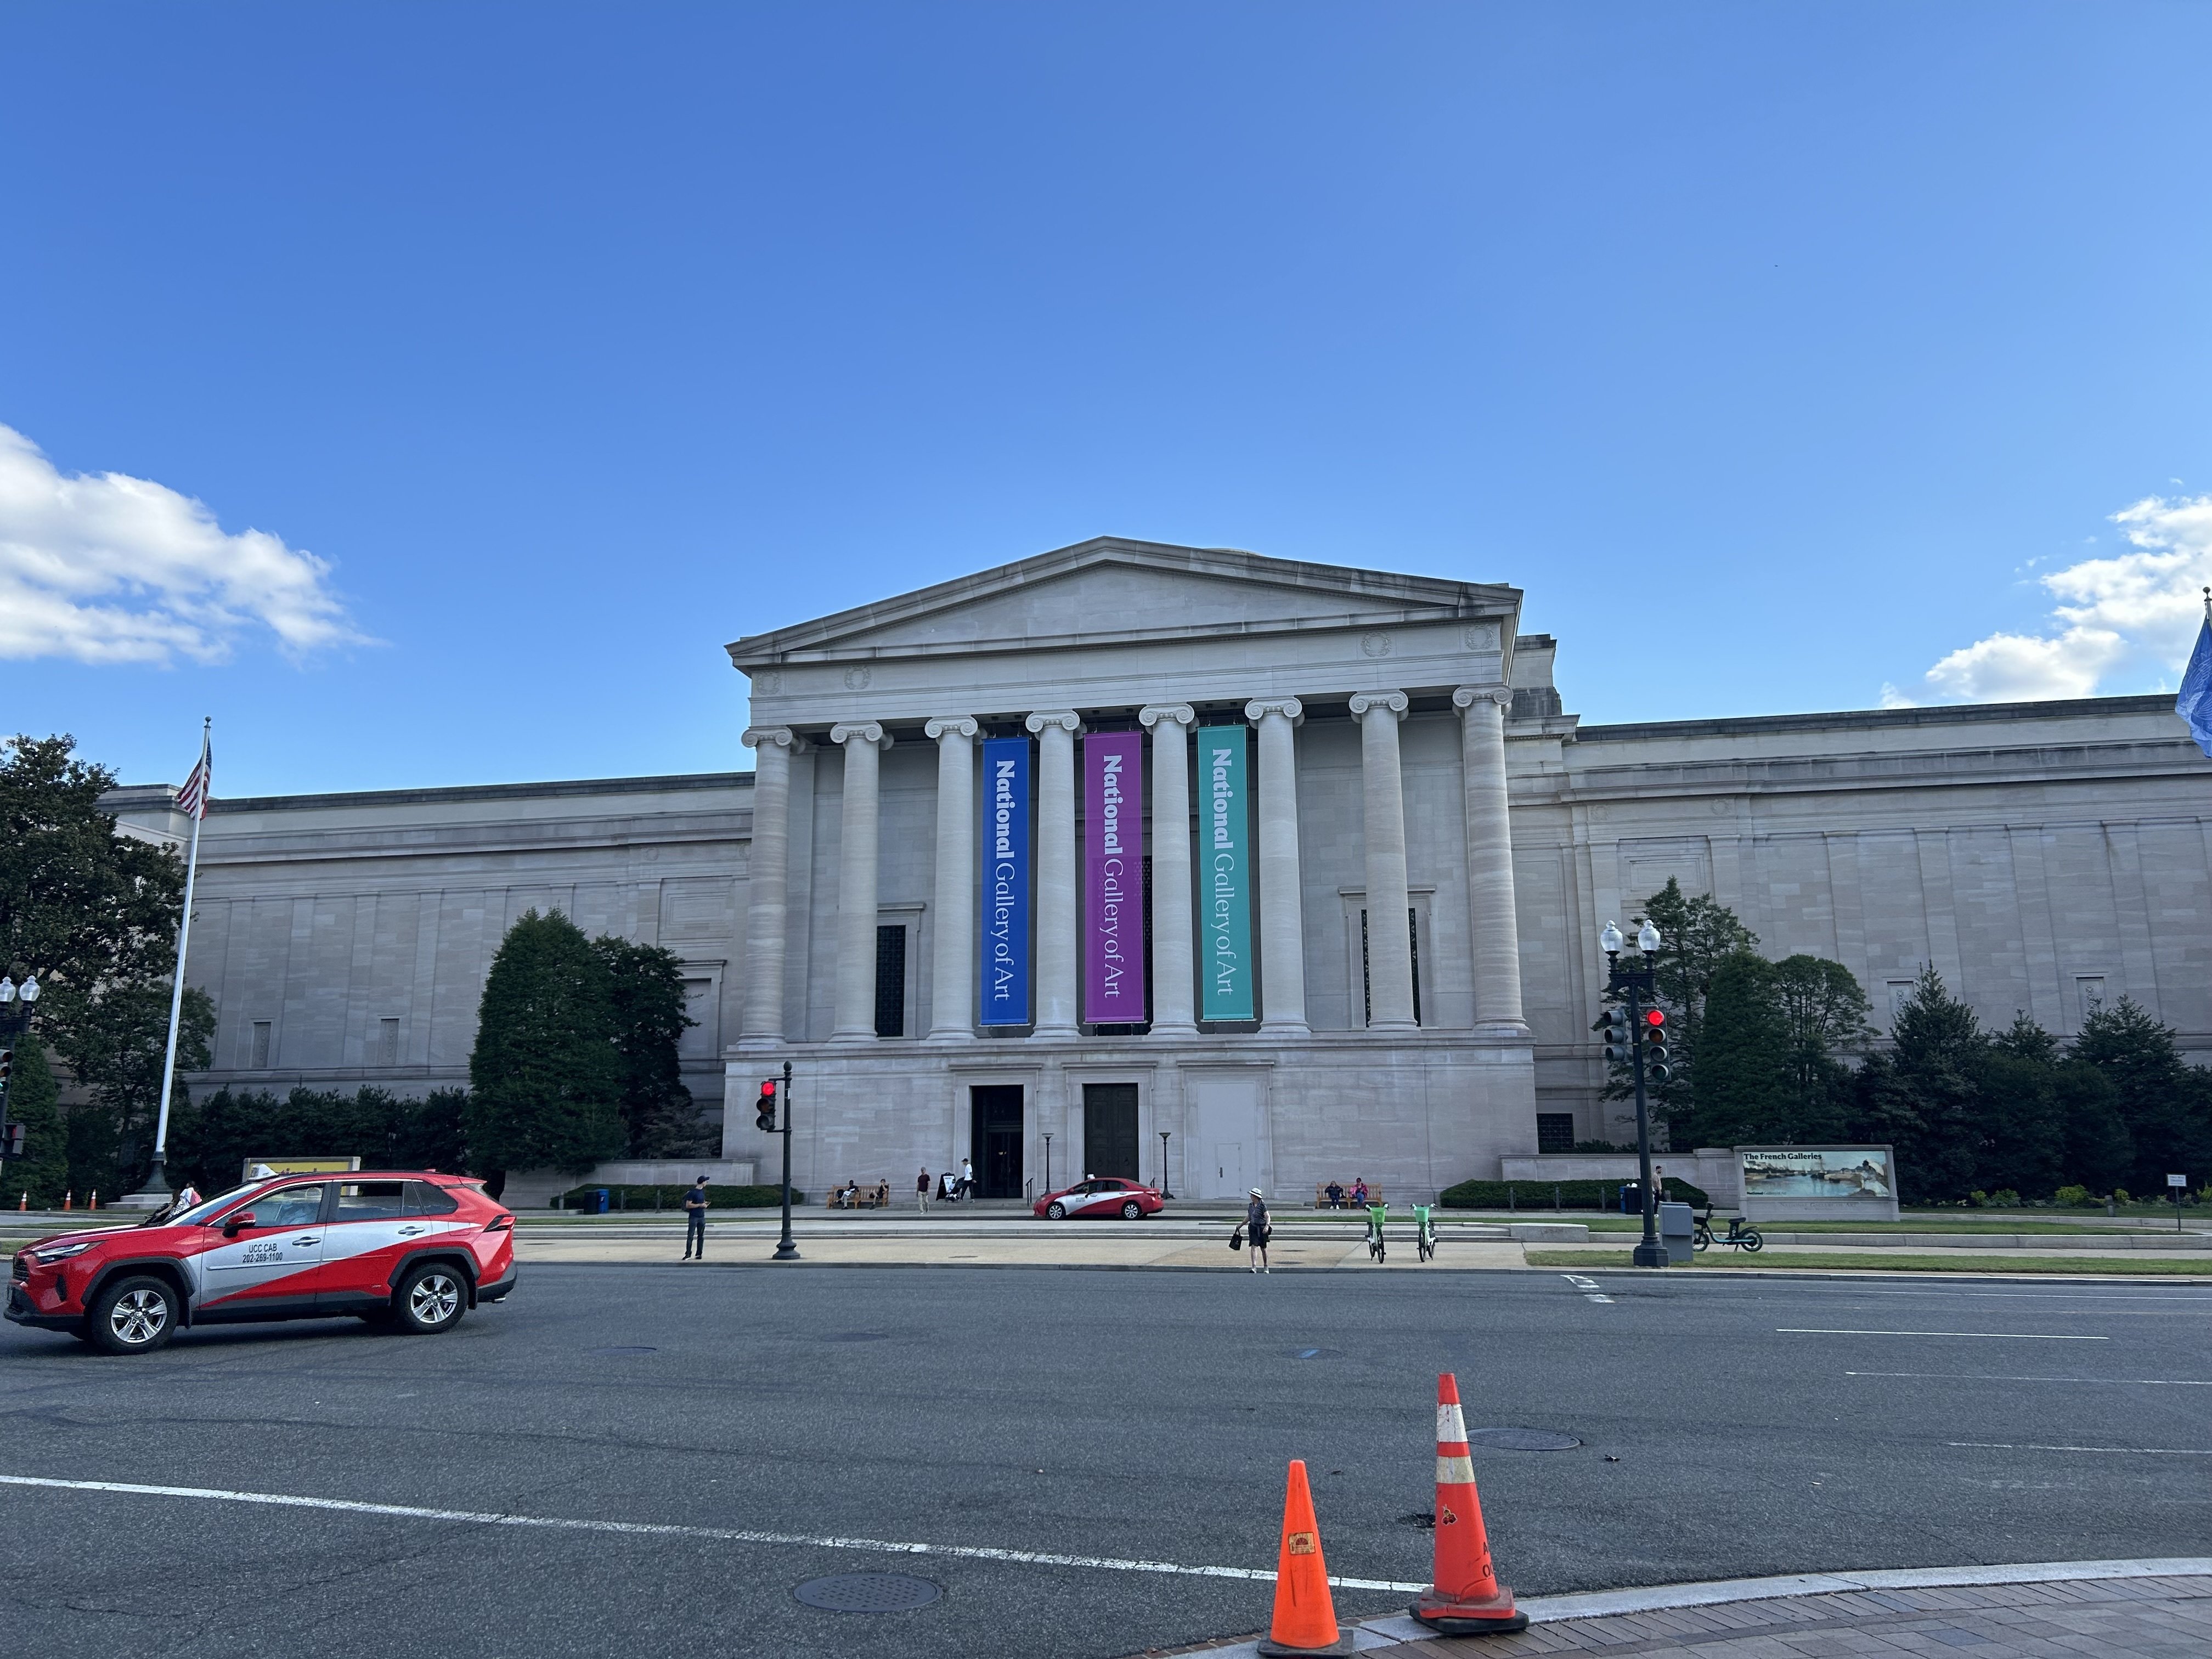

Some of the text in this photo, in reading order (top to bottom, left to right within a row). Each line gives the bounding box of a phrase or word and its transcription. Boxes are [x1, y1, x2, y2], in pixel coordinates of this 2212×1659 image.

[991, 760, 1015, 1001] National Gallery of Art
[1099, 755, 1124, 998] National Gallery of Art
[1211, 748, 1237, 996] National Gallery of Art
[242, 1252, 283, 1263] 202-269-1100
[249, 1243, 277, 1253] UCC CAB
